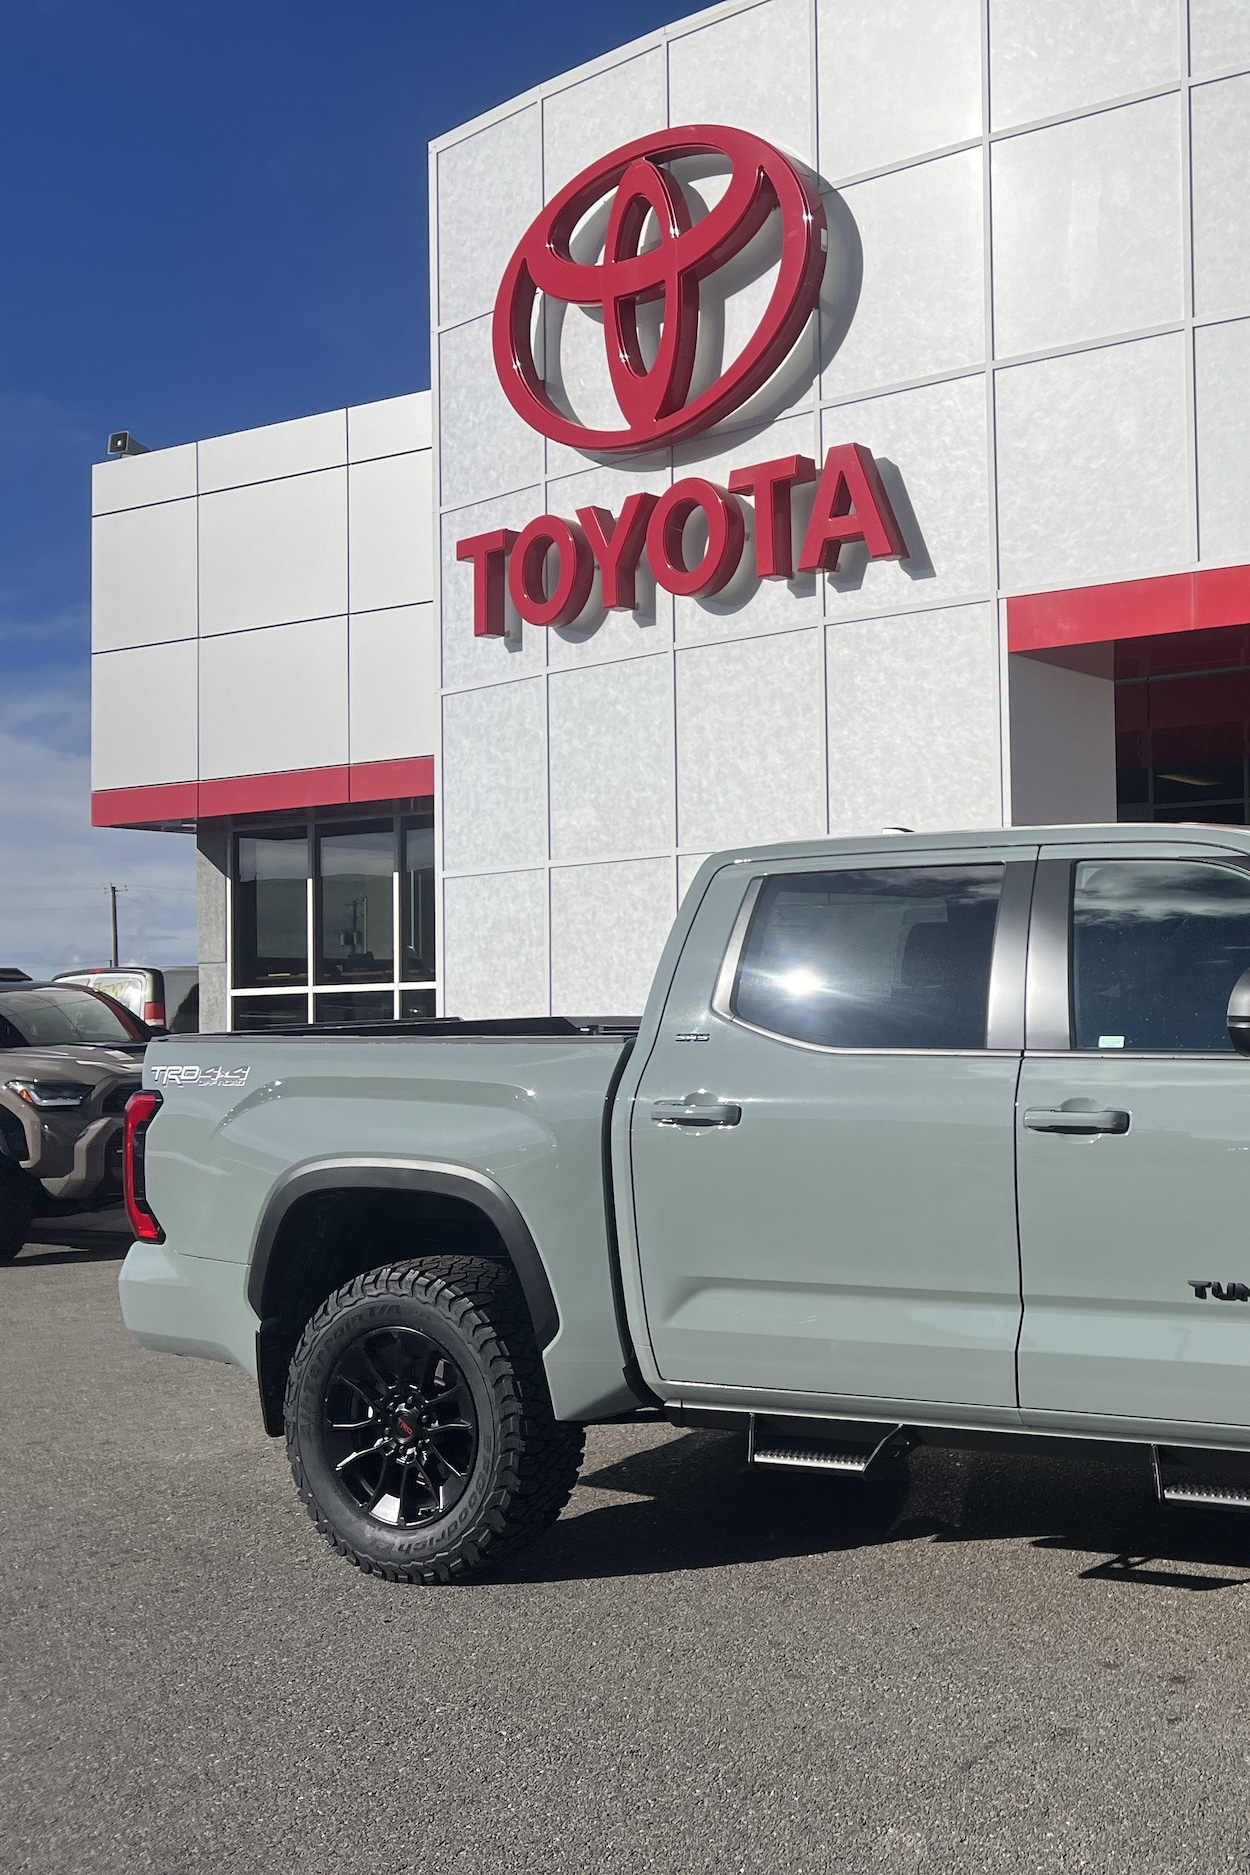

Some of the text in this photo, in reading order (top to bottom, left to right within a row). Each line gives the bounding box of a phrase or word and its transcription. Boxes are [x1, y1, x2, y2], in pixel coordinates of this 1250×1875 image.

[456, 442, 911, 640] TOYOTA
[151, 1066, 200, 1087] TRD
[397, 1417, 413, 1435] TRD
